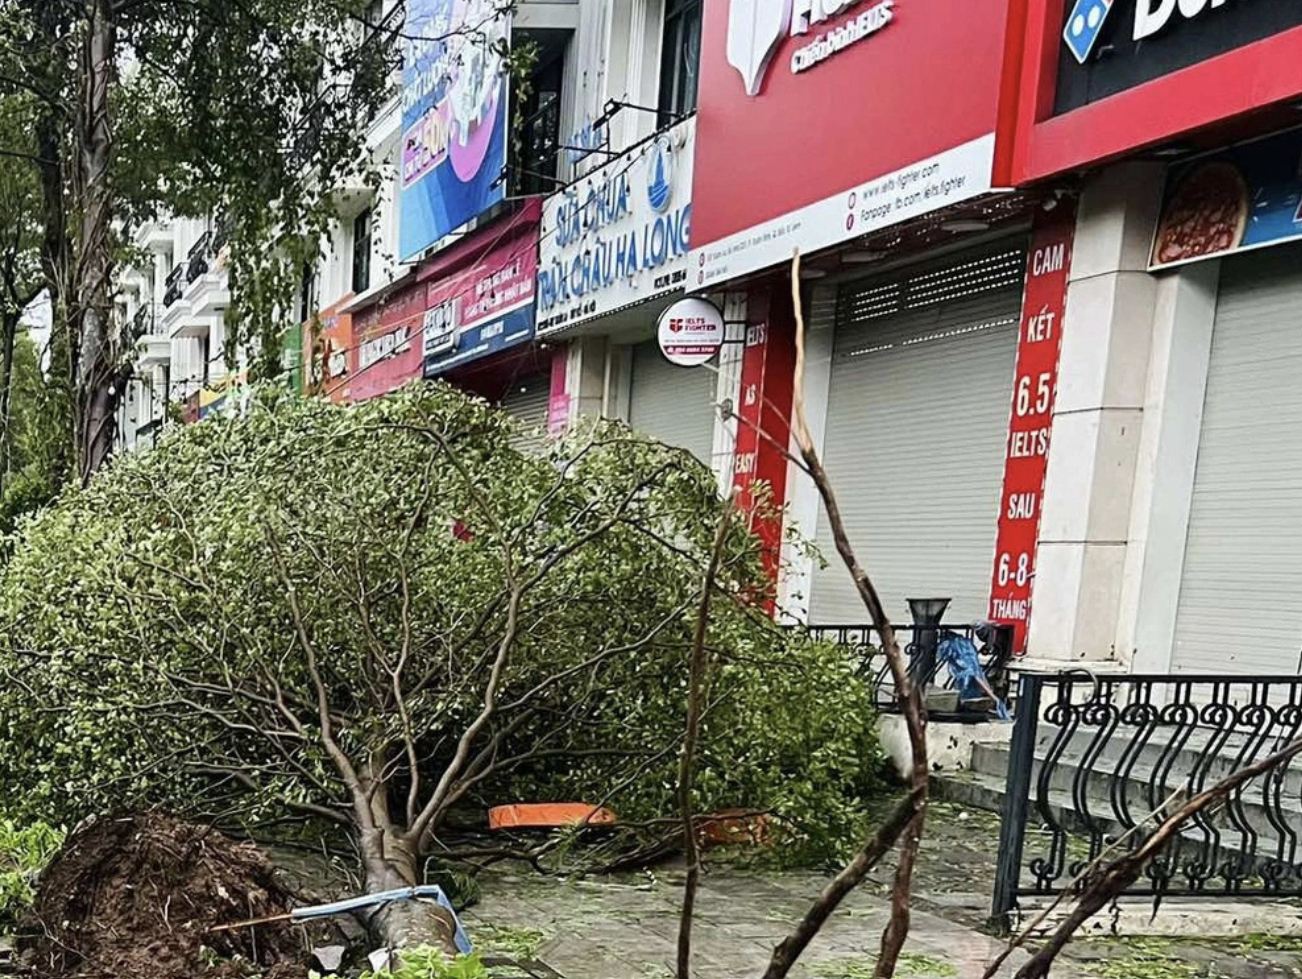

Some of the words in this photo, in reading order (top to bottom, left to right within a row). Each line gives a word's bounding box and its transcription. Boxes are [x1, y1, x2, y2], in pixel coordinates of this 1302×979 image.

[1033, 244, 1064, 276] CAM
[1027, 304, 1055, 343] KẾT
[1017, 373, 1050, 417] 6.5
[1010, 428, 1047, 457] IELTS
[735, 452, 755, 474] EASY
[1007, 493, 1035, 519] SAU
[999, 553, 1028, 587] 6-8
[993, 592, 1026, 620] THÁNG
